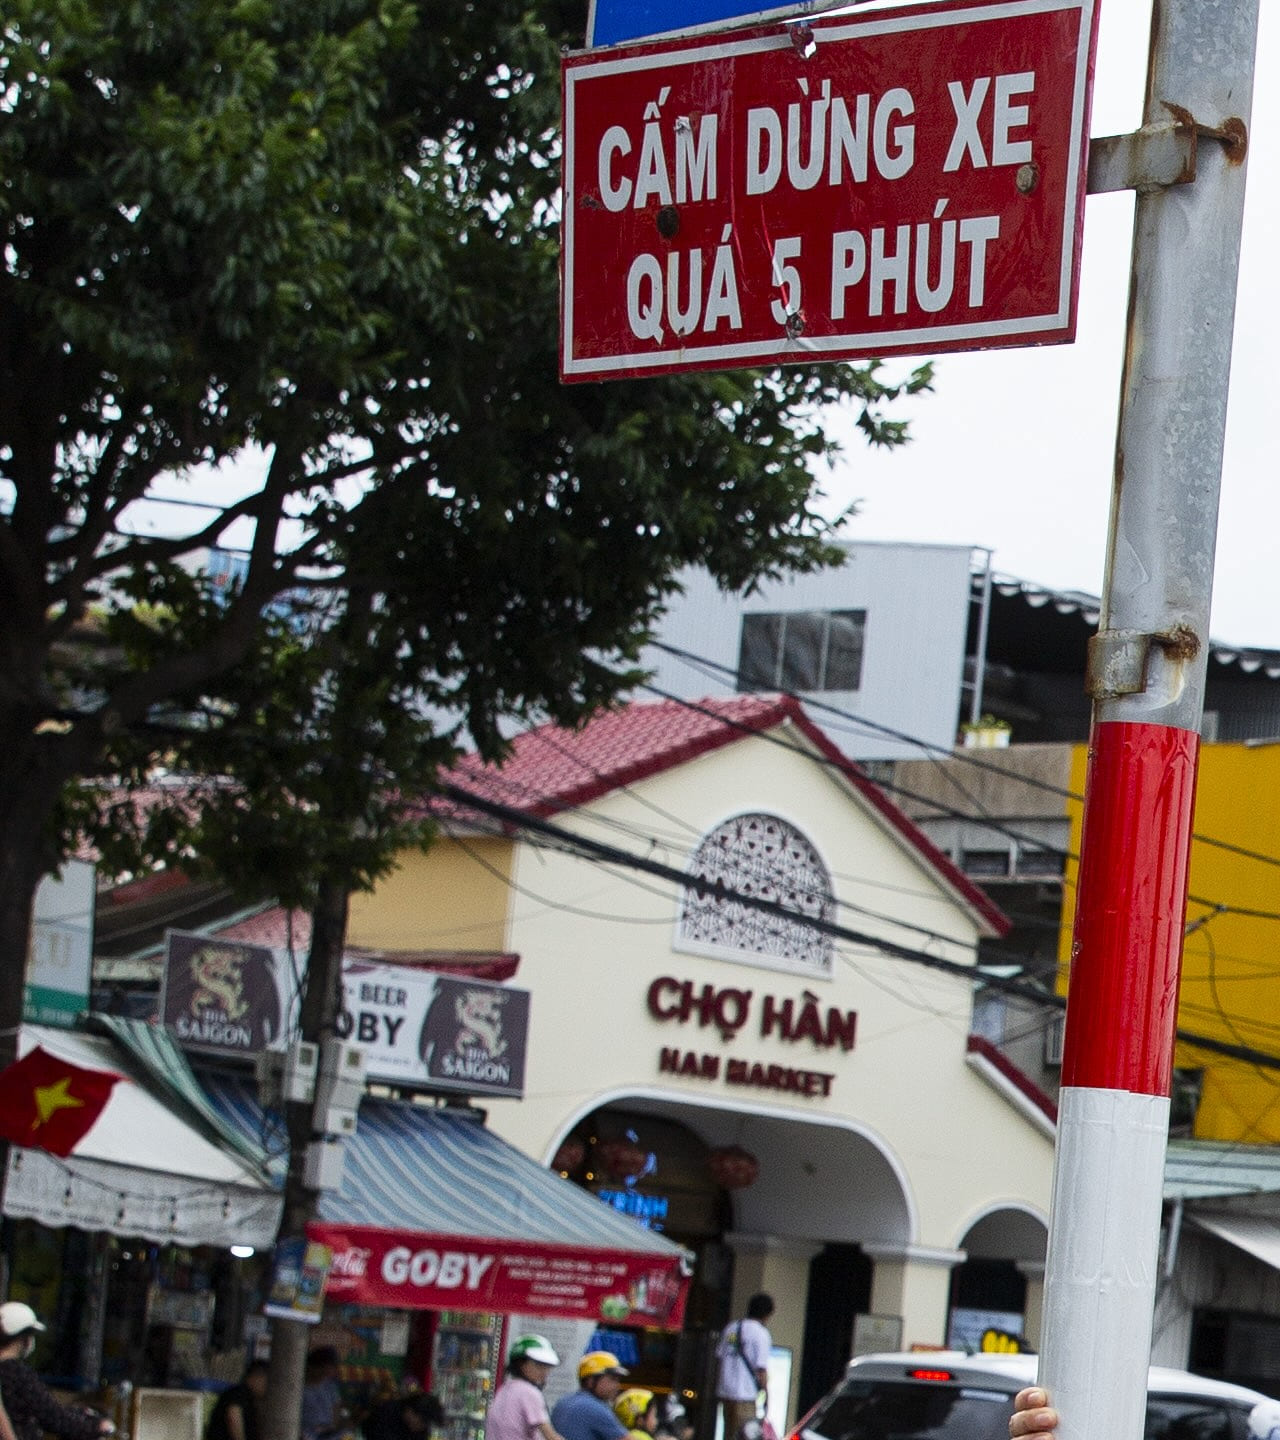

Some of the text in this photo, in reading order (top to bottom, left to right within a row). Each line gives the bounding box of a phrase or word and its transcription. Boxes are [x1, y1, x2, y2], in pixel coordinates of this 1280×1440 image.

[598, 73, 1036, 212] CẤM DỪNG XE
[625, 198, 1001, 344] QUÁ 5 PHÚT
[361, 984, 407, 1006] BEER
[647, 976, 857, 1052] CHỢ HÀN
[336, 1010, 405, 1046] OBY
[659, 1047, 835, 1098] HAN MARKET
[380, 1246, 492, 1290] GOBY
